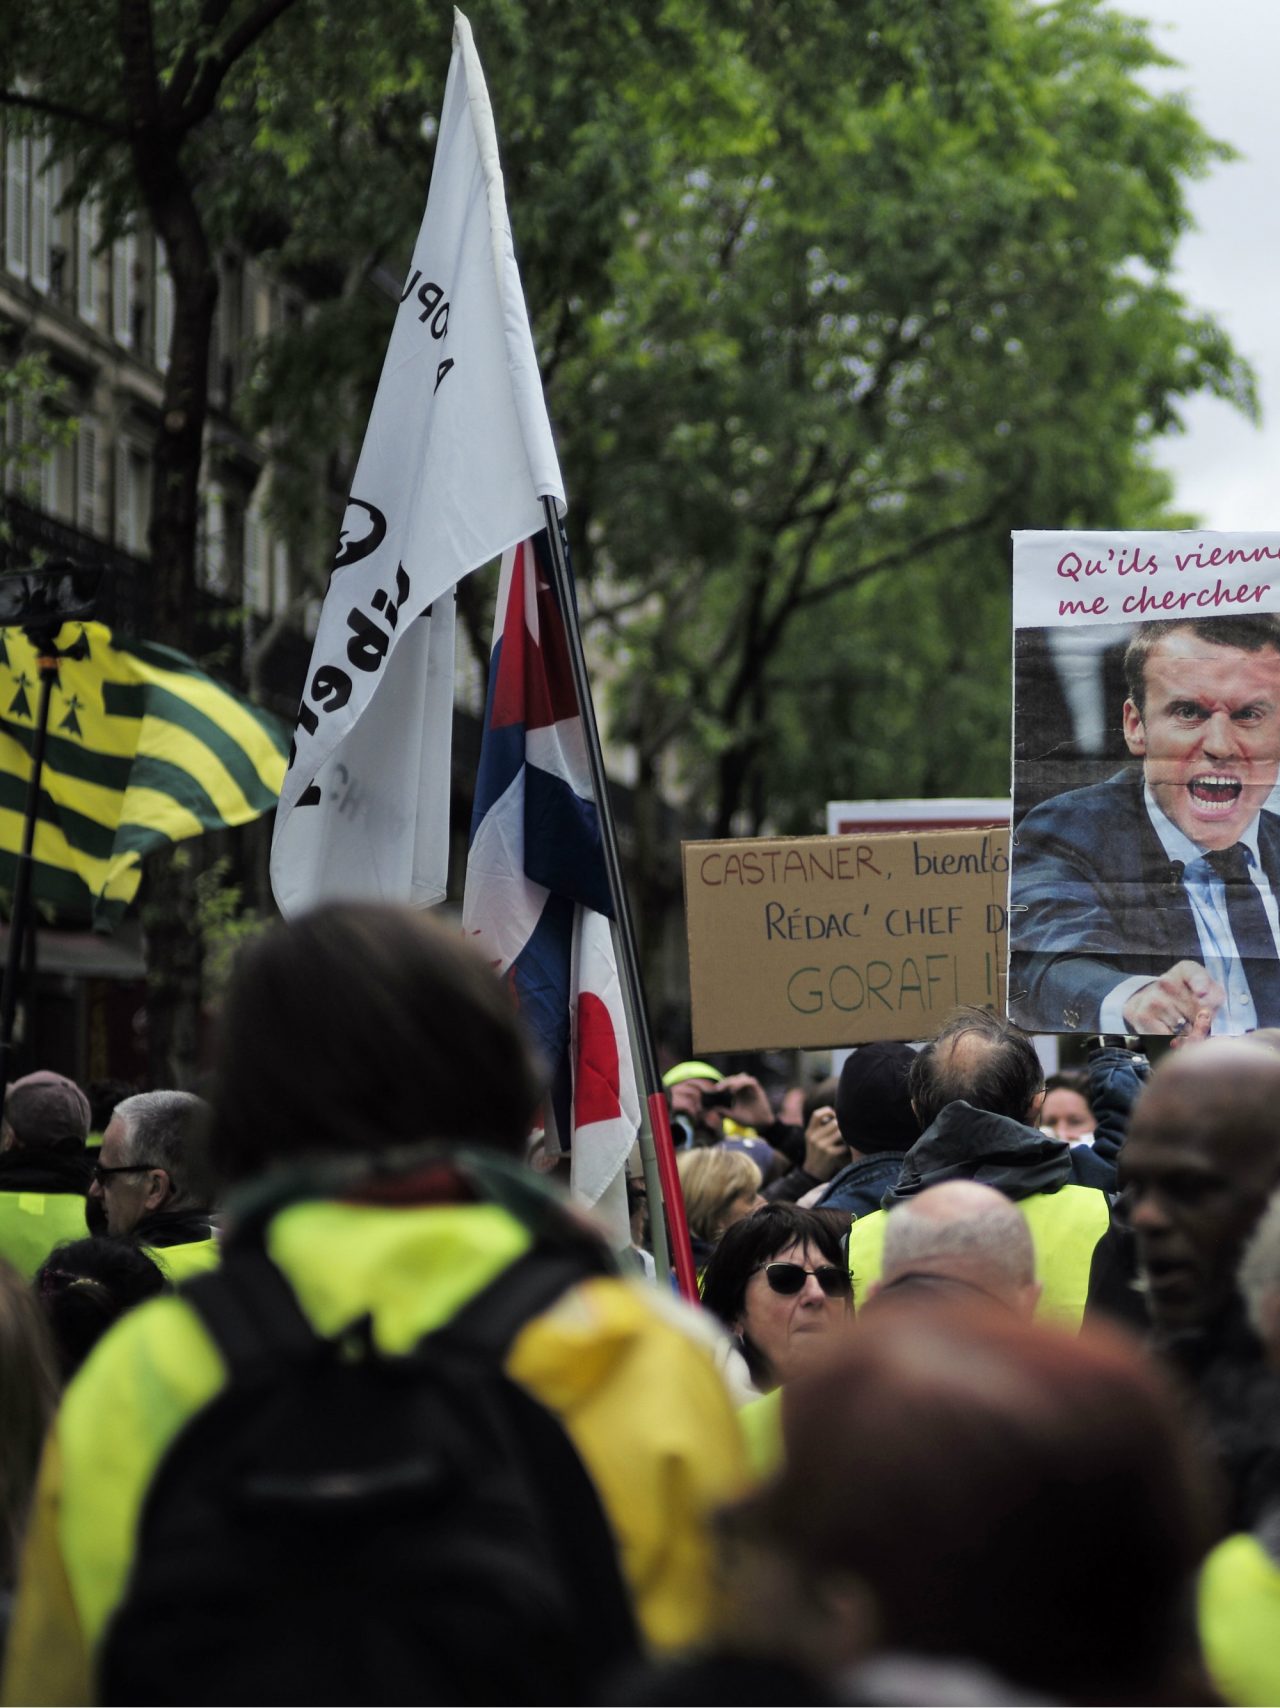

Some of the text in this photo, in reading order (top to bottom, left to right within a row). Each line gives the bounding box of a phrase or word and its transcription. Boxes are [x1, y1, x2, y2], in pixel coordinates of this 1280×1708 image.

[1057, 548, 1158, 582] Qu'ils
[1058, 596, 1109, 616] me
[1122, 579, 1271, 614] chercher
[700, 845, 892, 887] CASTANER,
[885, 906, 963, 936] CHEF
[986, 904, 1009, 934] D
[787, 954, 959, 1014] GORAFI
